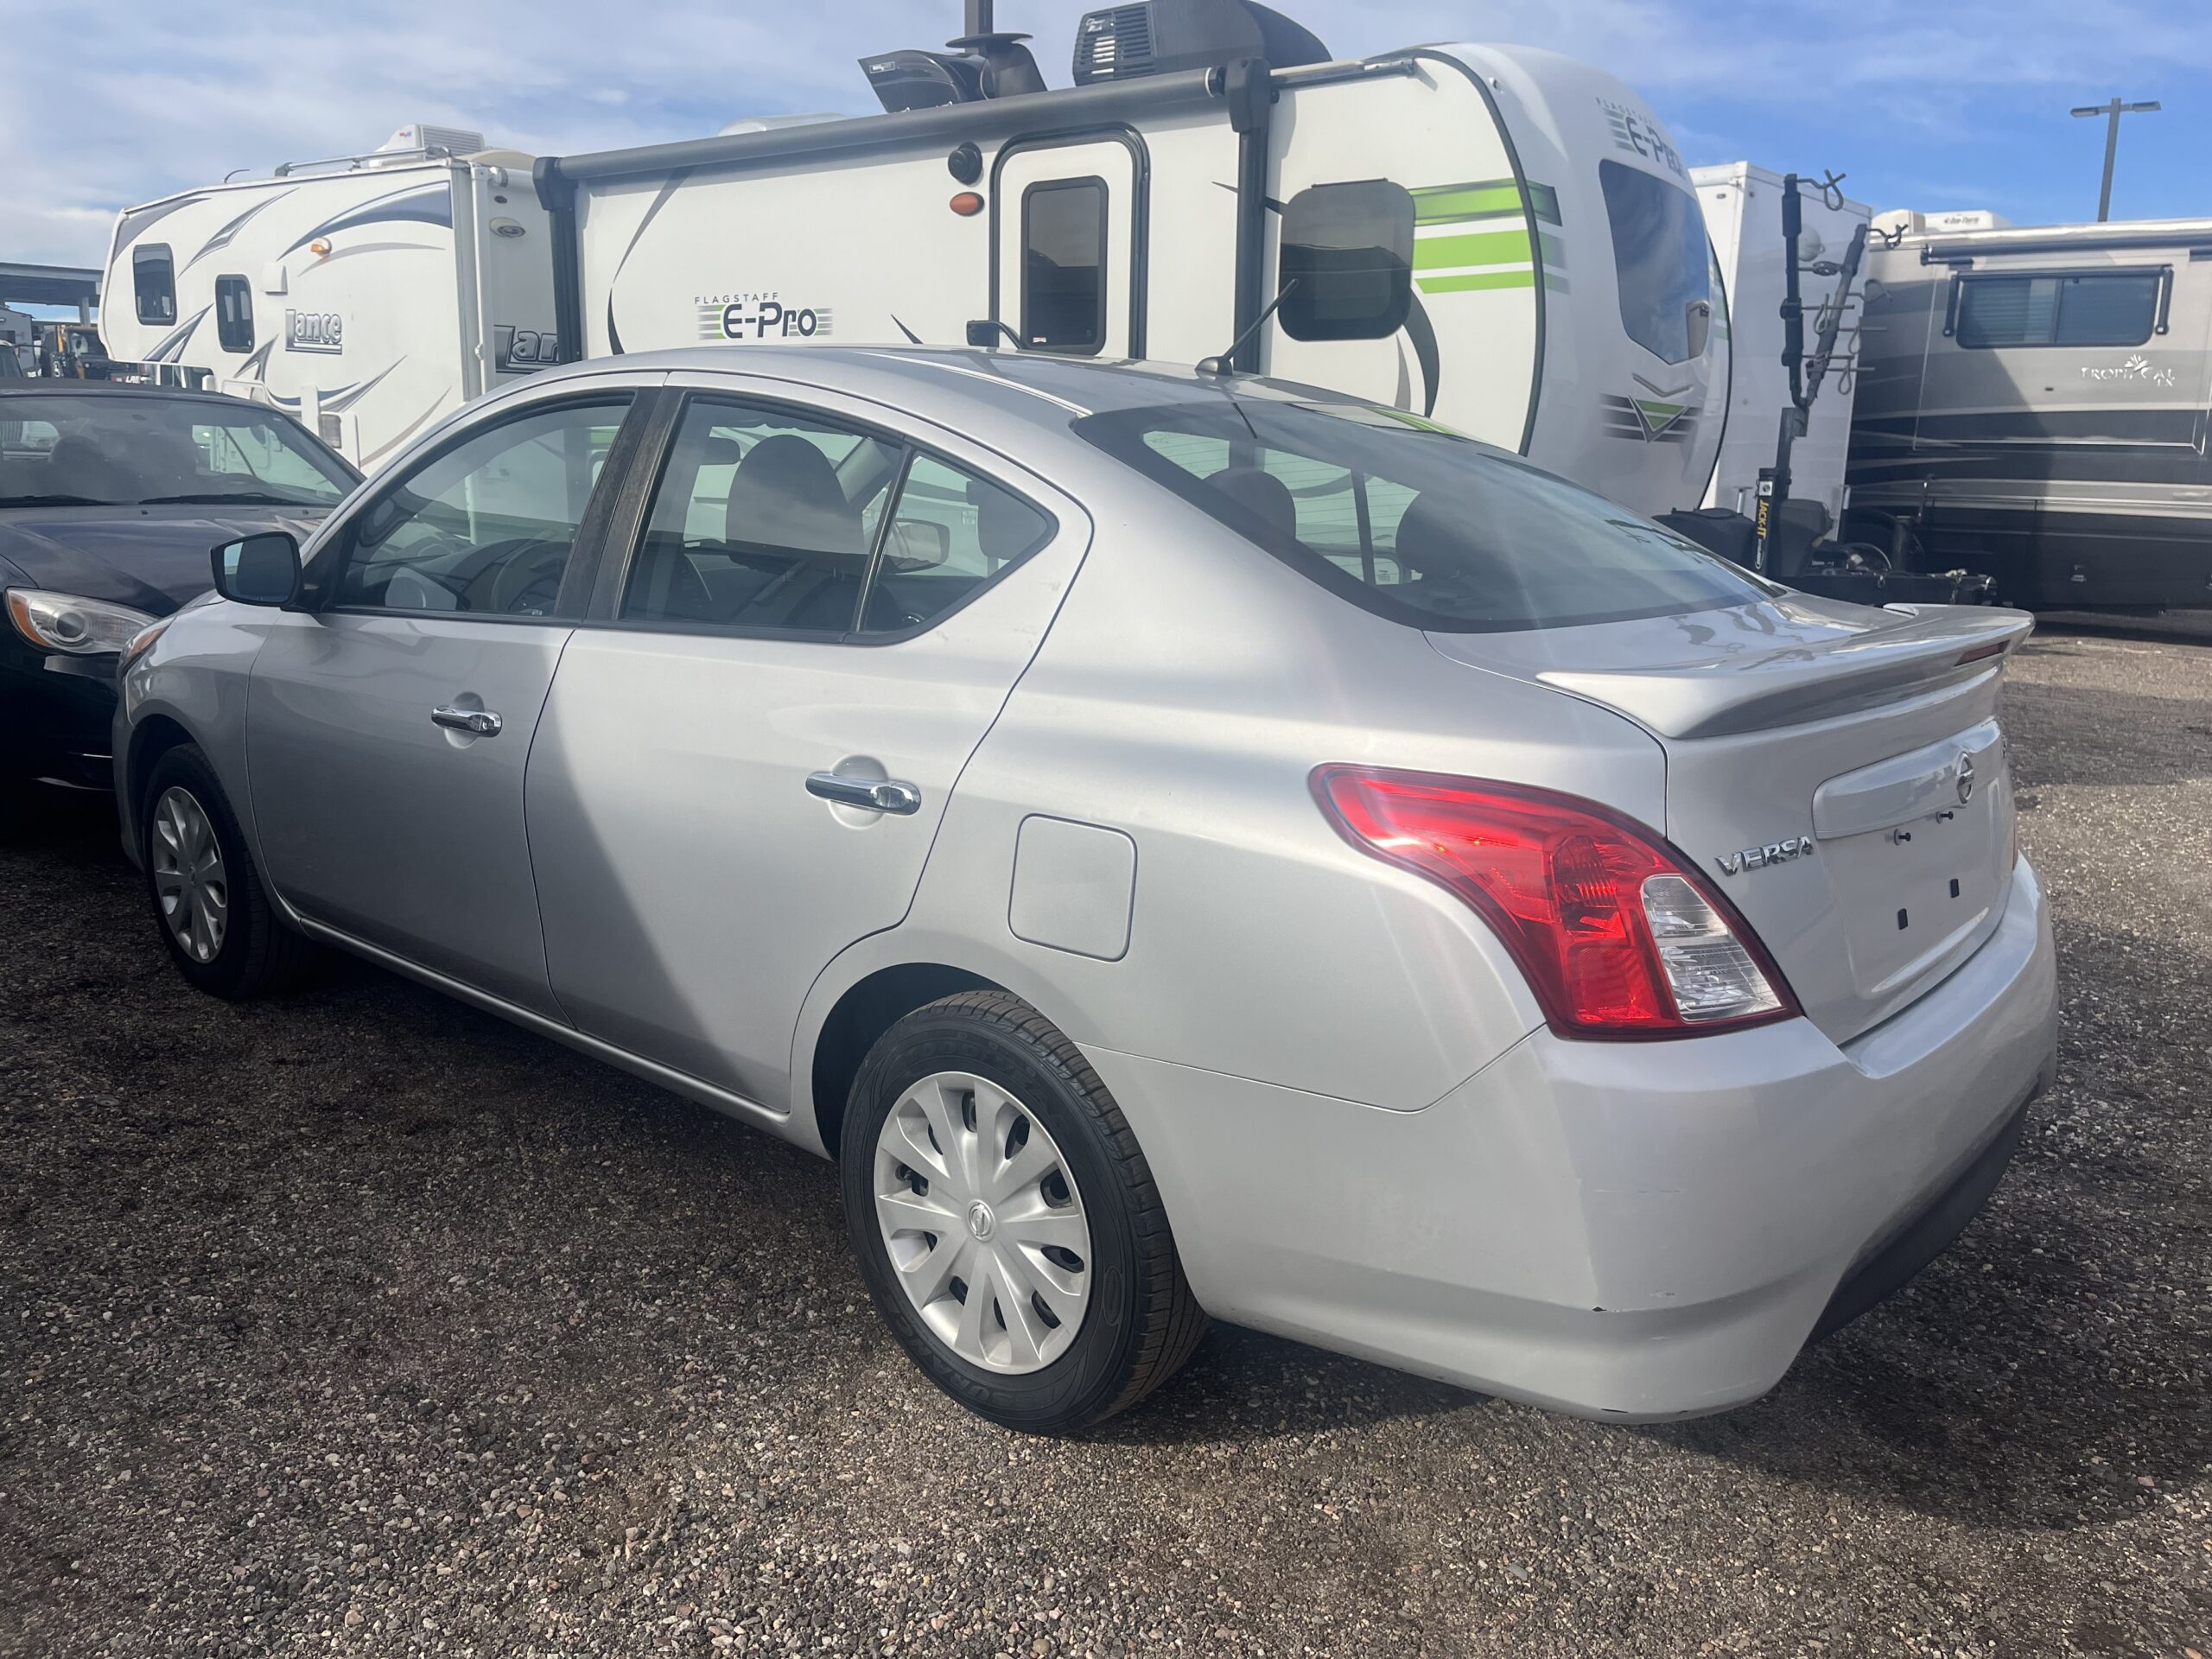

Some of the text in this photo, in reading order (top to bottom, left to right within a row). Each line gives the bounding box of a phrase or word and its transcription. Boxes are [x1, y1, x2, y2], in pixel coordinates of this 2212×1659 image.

[694, 292, 779, 305] FLAGSTAFF
[285, 308, 343, 355] Lance
[722, 302, 817, 339] E-Pro
[1714, 836, 1814, 876] VERSA
